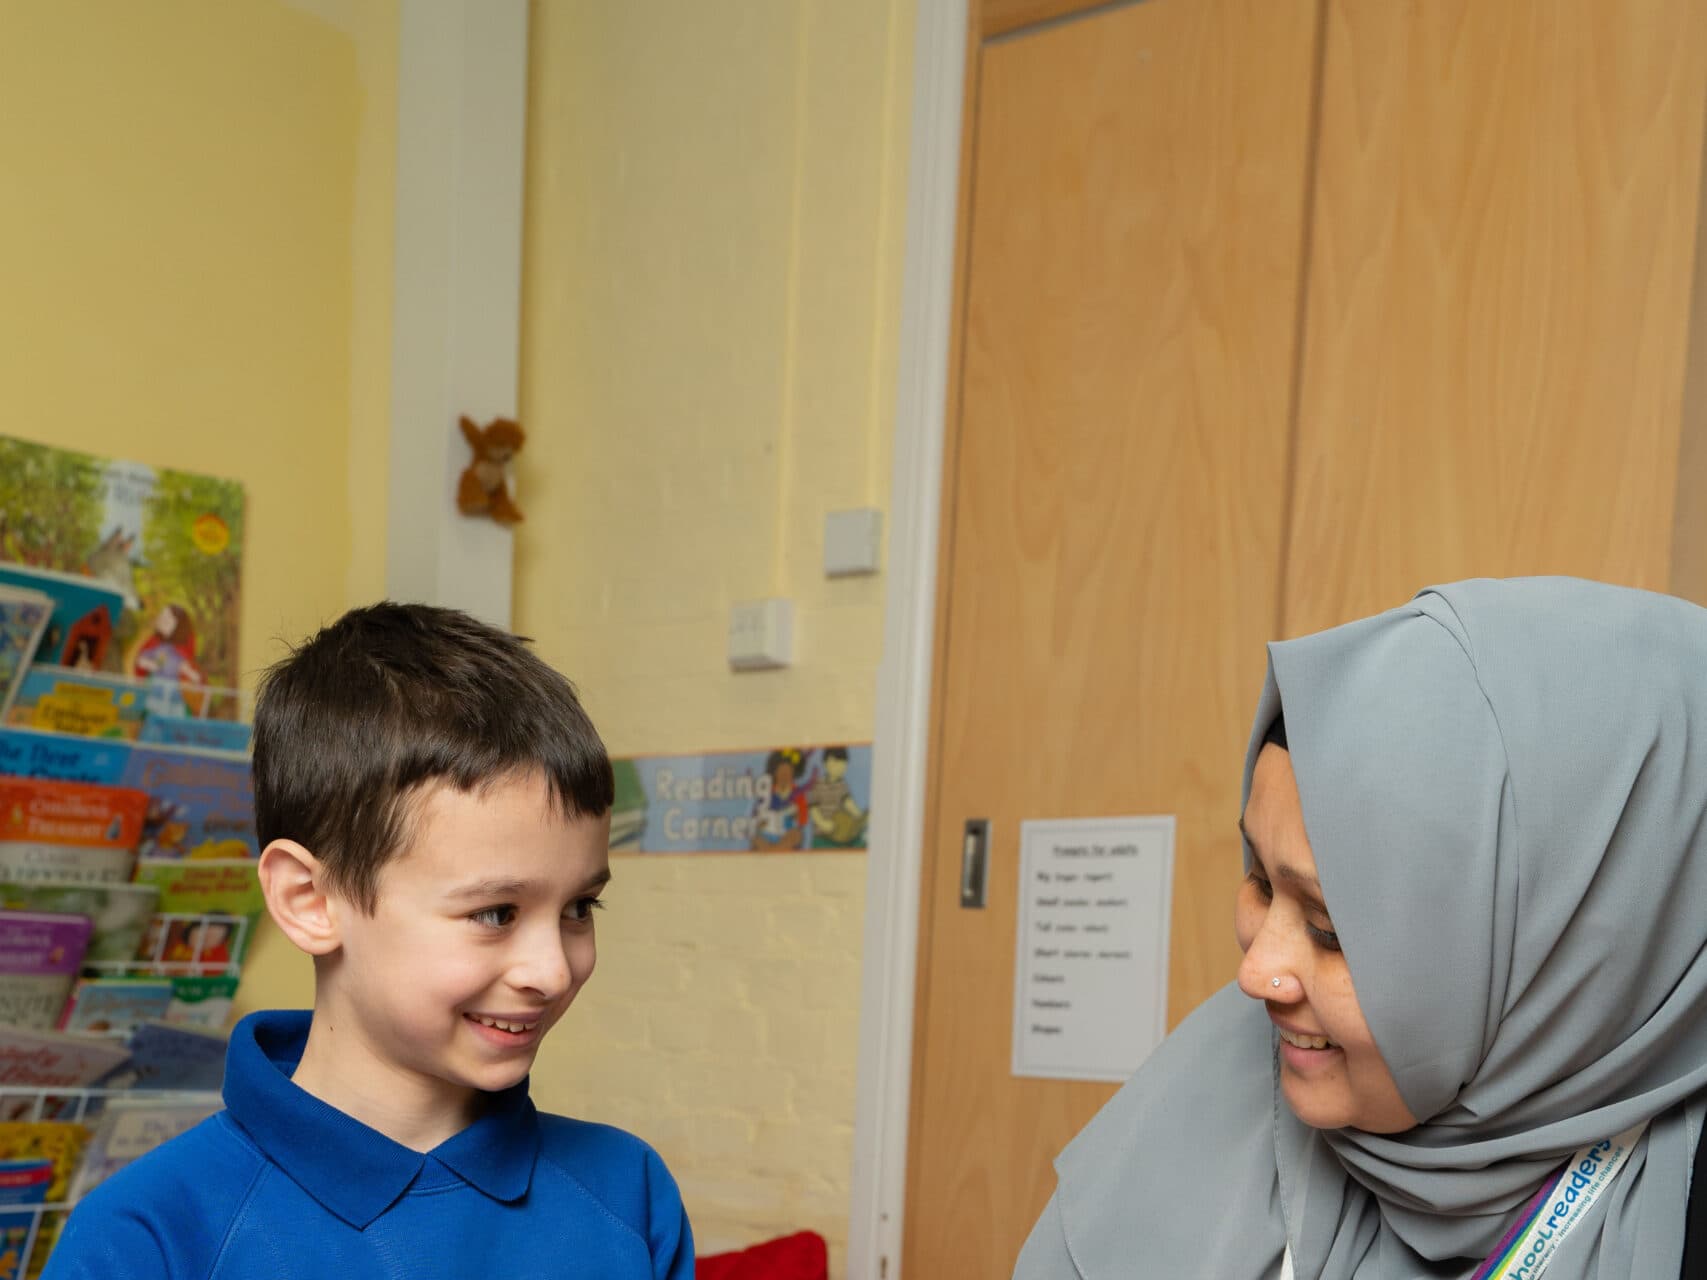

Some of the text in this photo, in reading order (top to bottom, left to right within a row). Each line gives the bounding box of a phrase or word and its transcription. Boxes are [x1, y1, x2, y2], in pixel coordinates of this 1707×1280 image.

[655, 767, 773, 809] Reading
[663, 807, 759, 841] Corner
[1589, 1179, 1600, 1196] life
